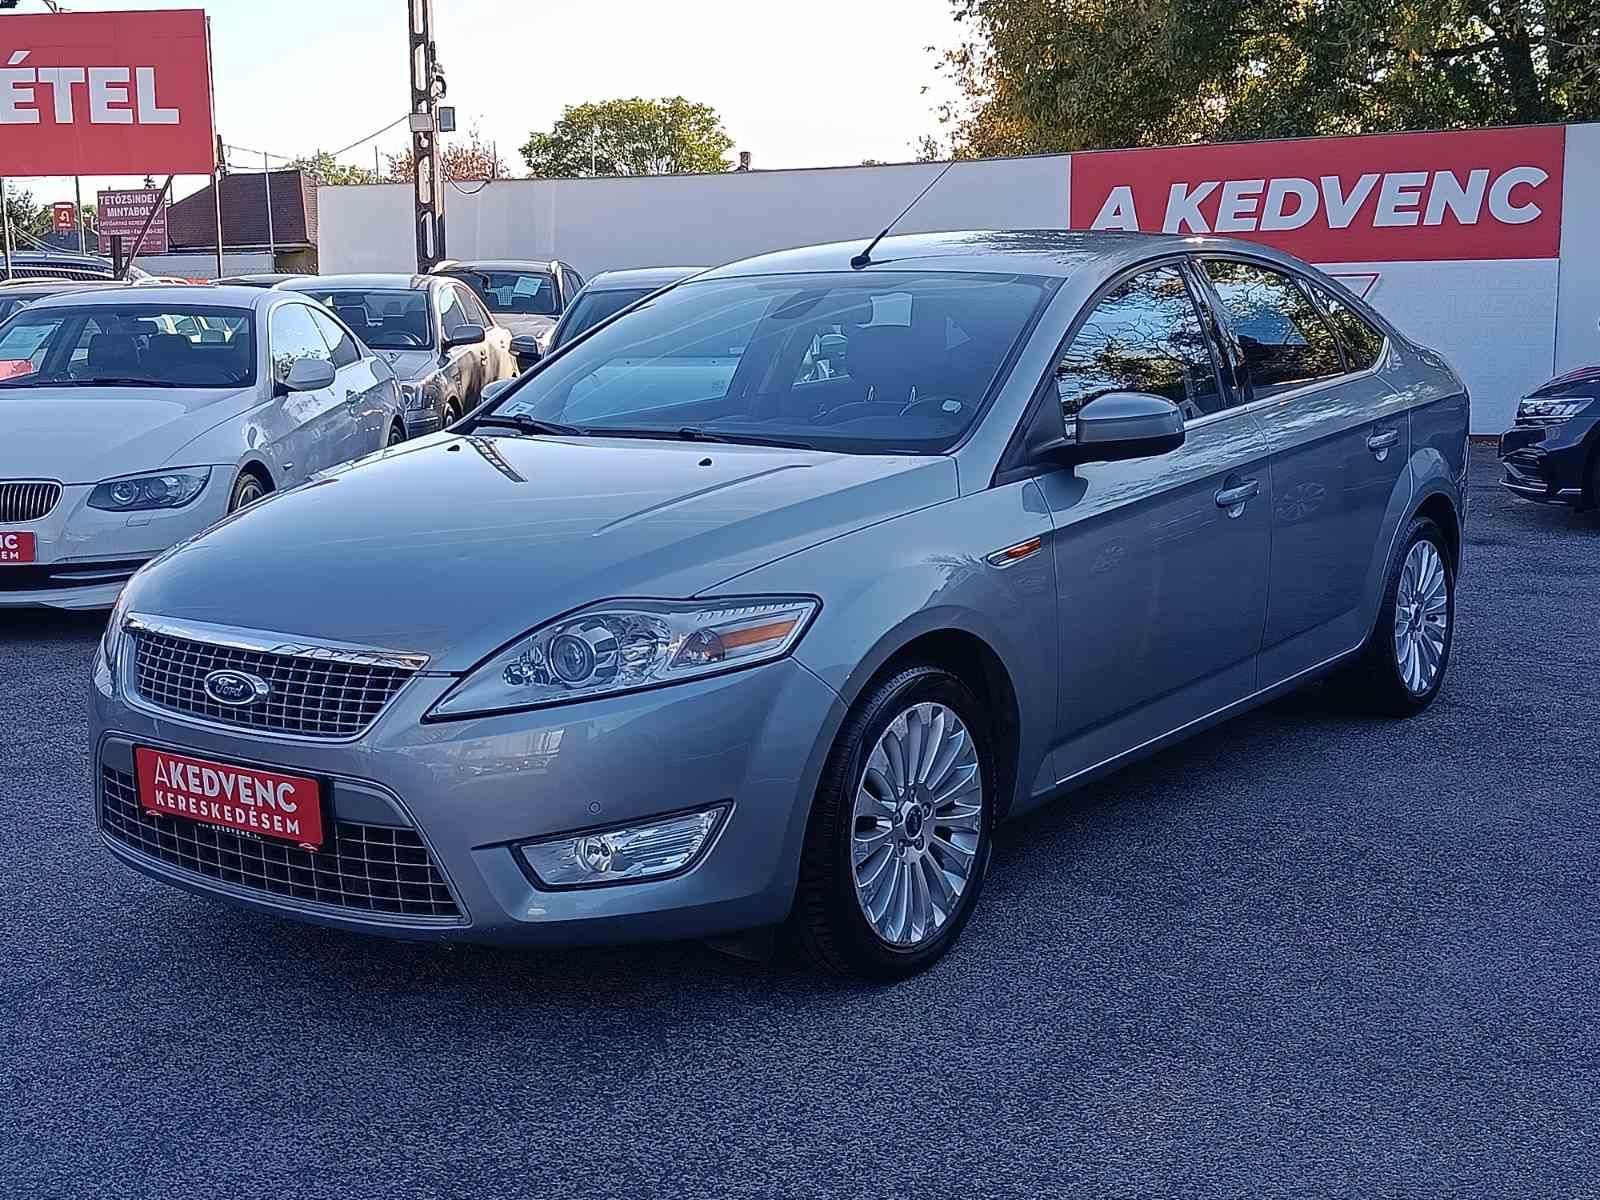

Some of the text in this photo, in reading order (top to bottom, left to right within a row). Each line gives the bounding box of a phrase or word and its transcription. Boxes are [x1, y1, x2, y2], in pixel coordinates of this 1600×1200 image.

[1090, 167, 1549, 233] A KEDVENC
[215, 677, 244, 697] Ford
[154, 790, 300, 835] KERESKEDÉSEM
